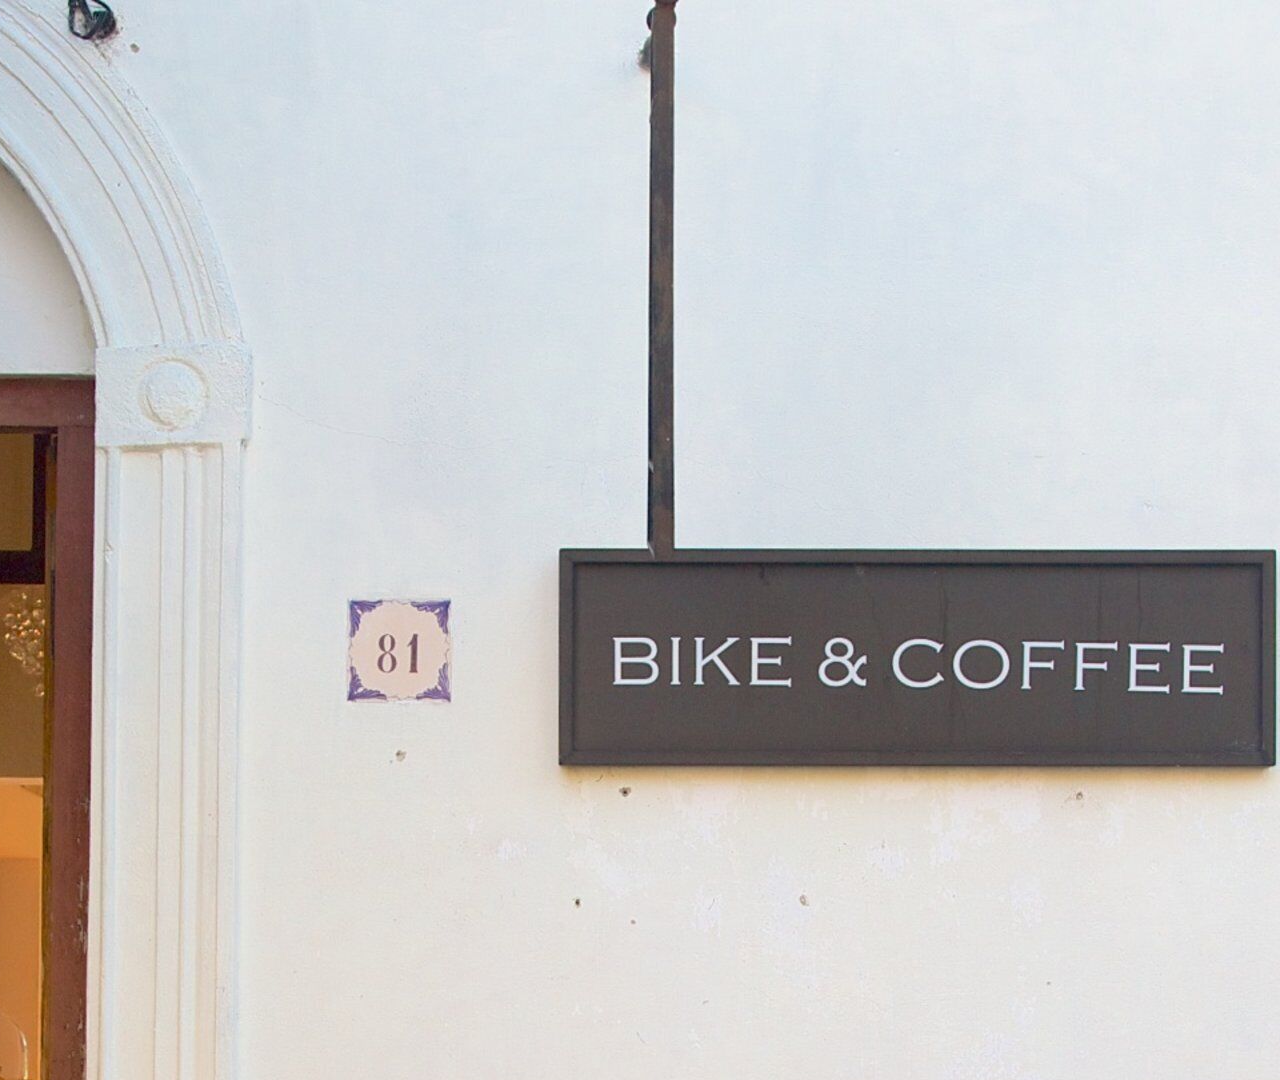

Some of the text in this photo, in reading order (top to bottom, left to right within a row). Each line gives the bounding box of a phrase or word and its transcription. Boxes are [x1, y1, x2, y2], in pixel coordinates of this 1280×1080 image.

[377, 633, 418, 674] 81
[612, 636, 1226, 697] BIKE & COFFEE
